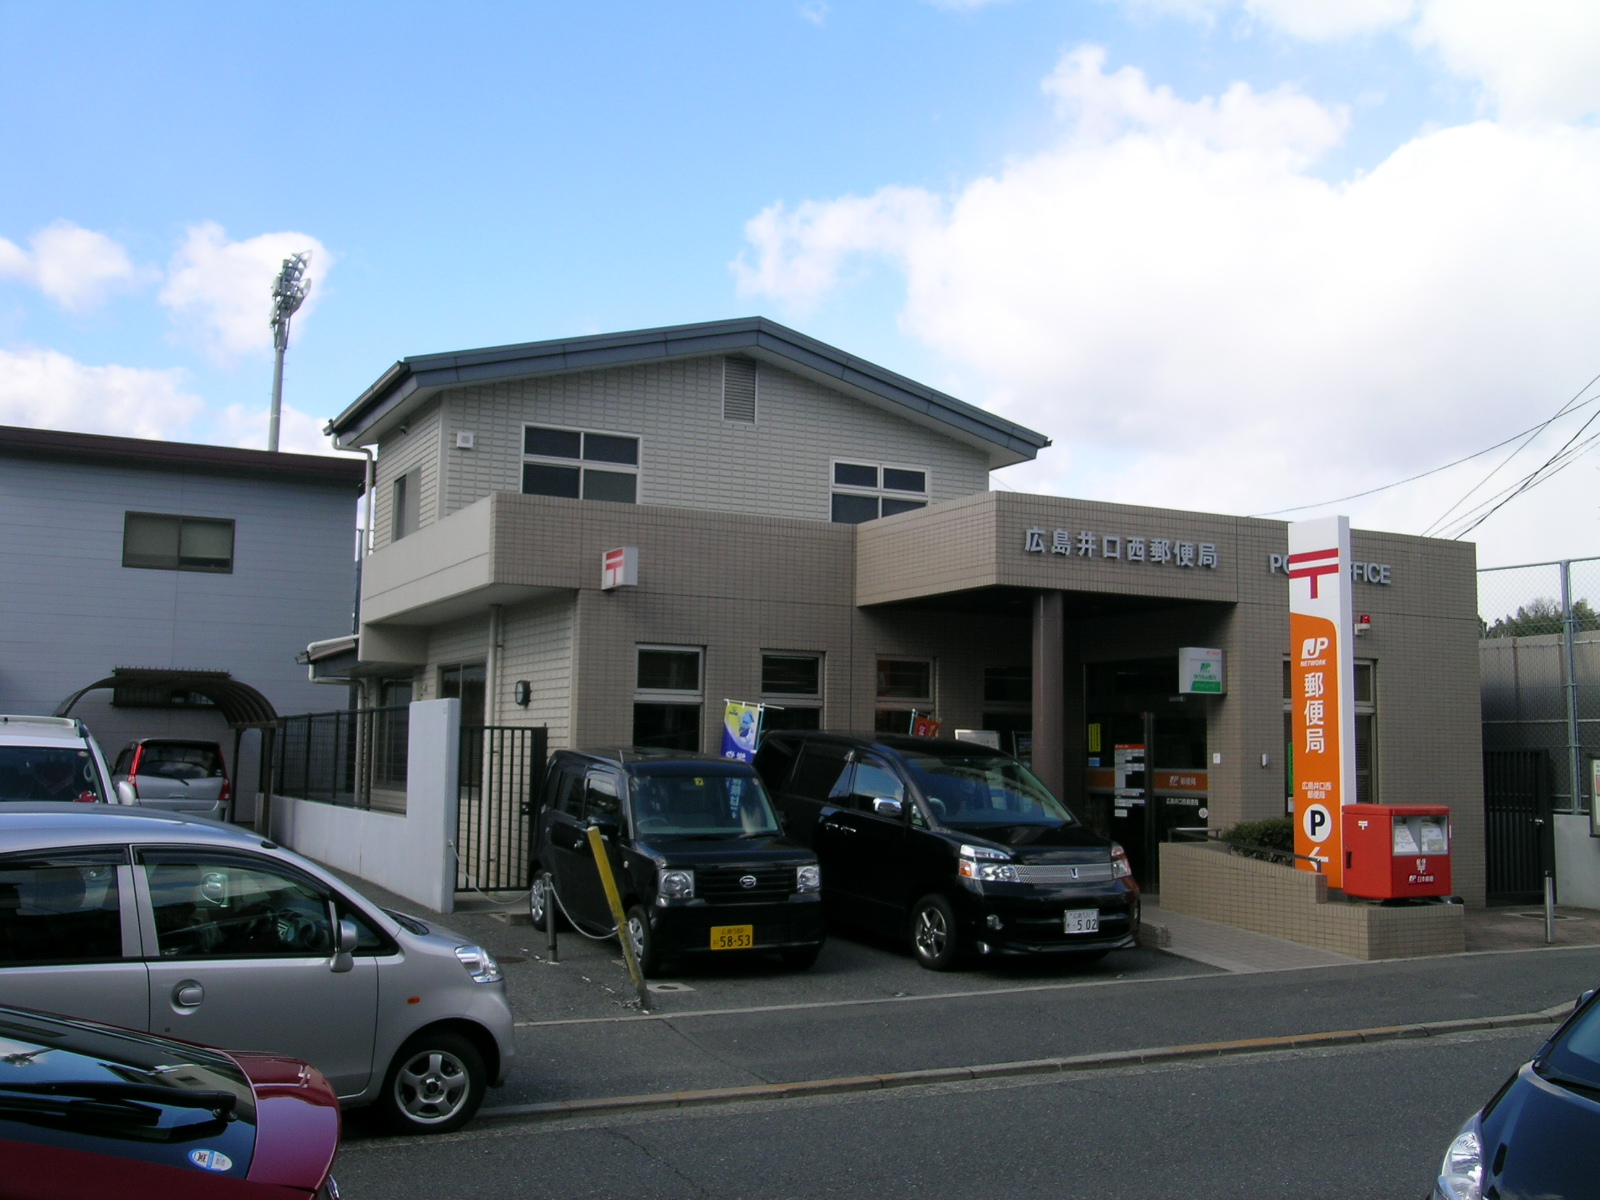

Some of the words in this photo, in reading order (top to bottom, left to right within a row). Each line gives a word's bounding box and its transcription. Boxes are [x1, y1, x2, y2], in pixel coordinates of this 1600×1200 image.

[1025, 525, 1219, 570] 広島井口西郵便局
[1304, 672, 1324, 754] 郵便局
[1310, 809, 1325, 837] P
[720, 934, 751, 947] 58-53
